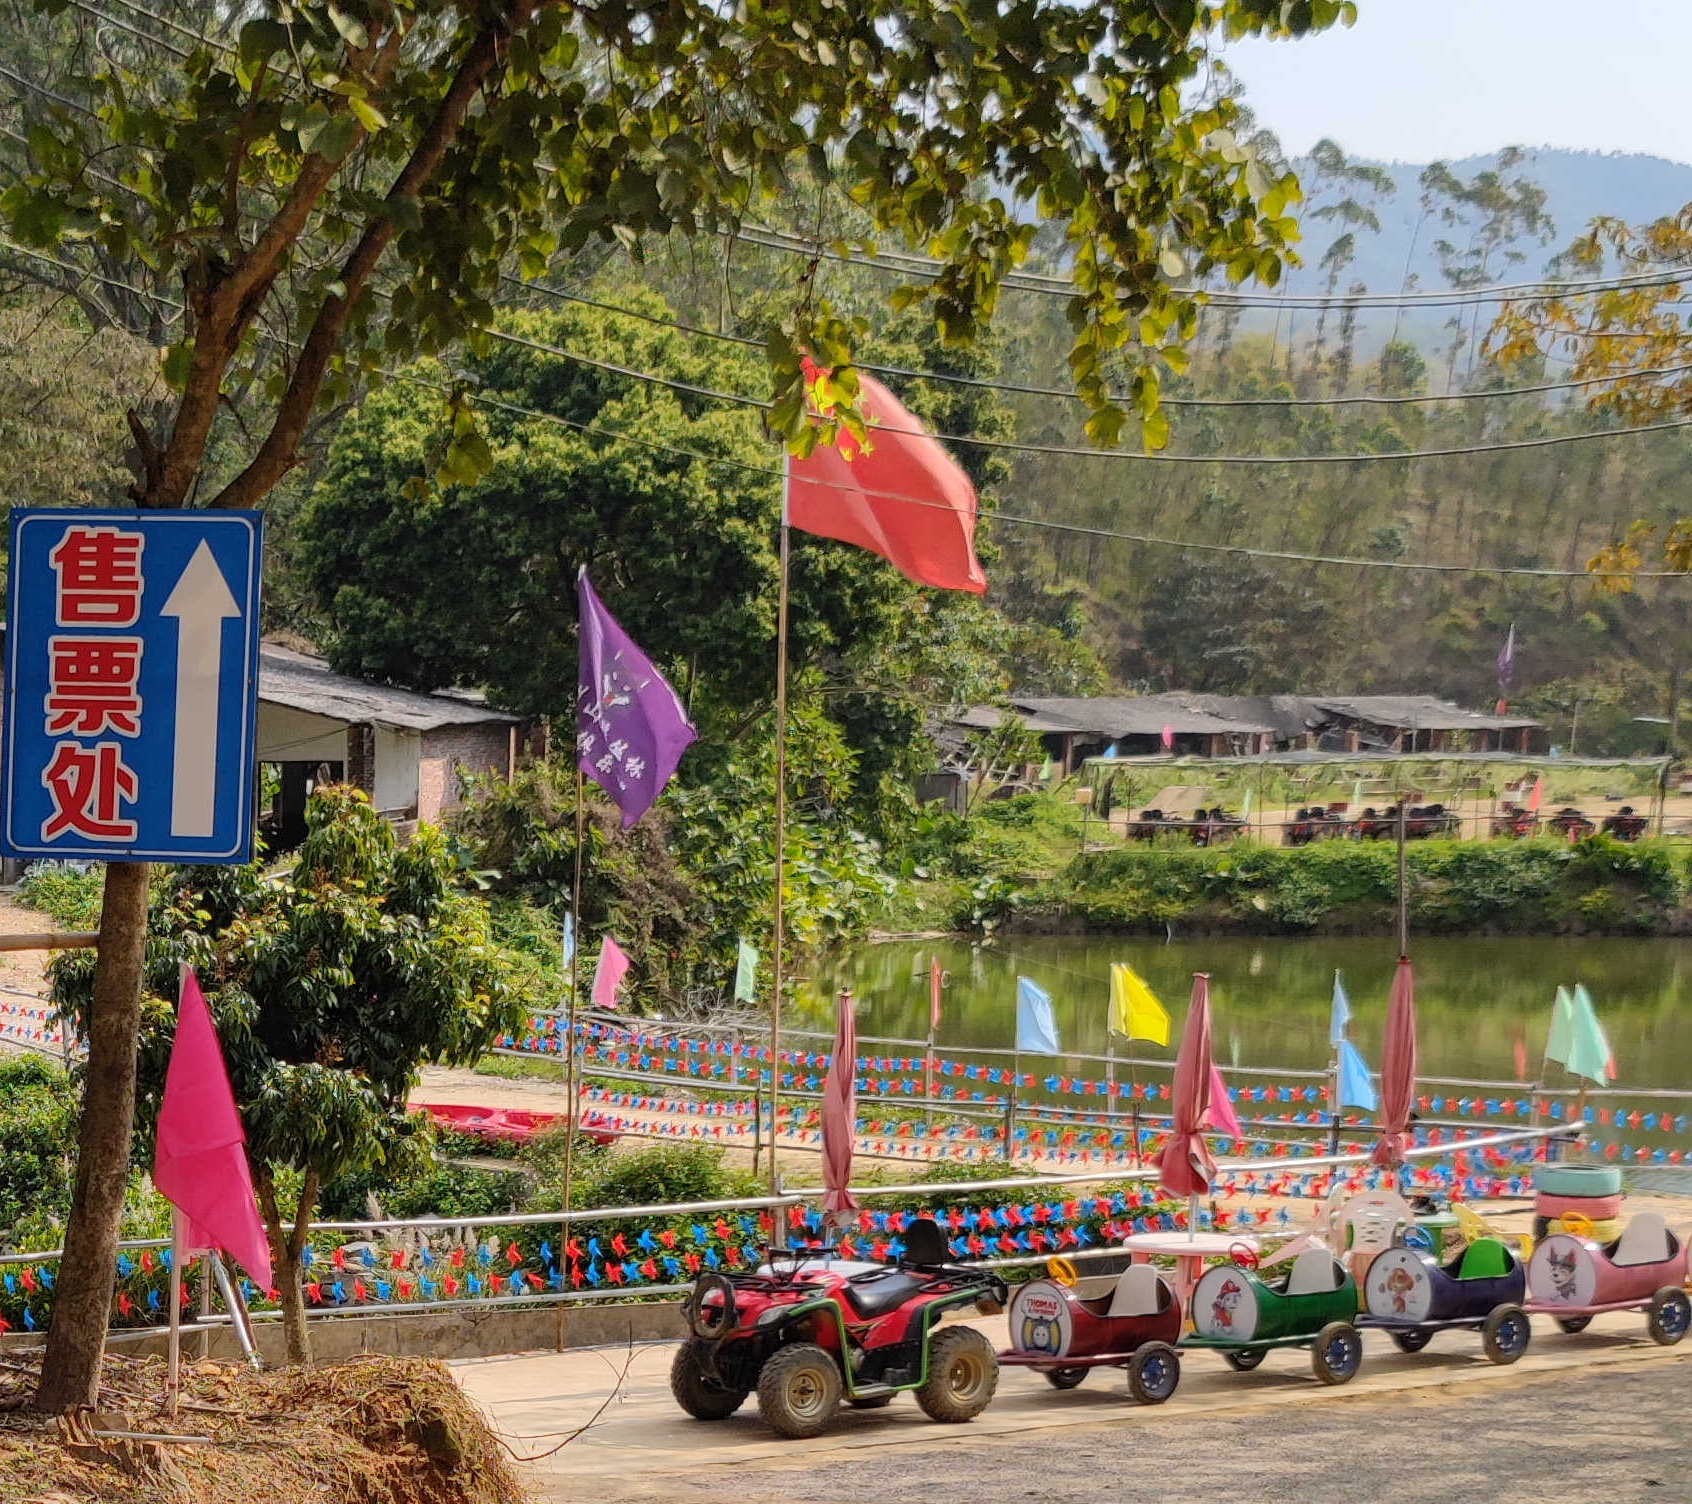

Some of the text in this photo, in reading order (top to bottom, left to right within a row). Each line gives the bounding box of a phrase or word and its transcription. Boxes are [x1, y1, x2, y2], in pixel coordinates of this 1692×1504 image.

[41, 525, 146, 843] 售票处
[1026, 1298, 1058, 1311] THOMAS
